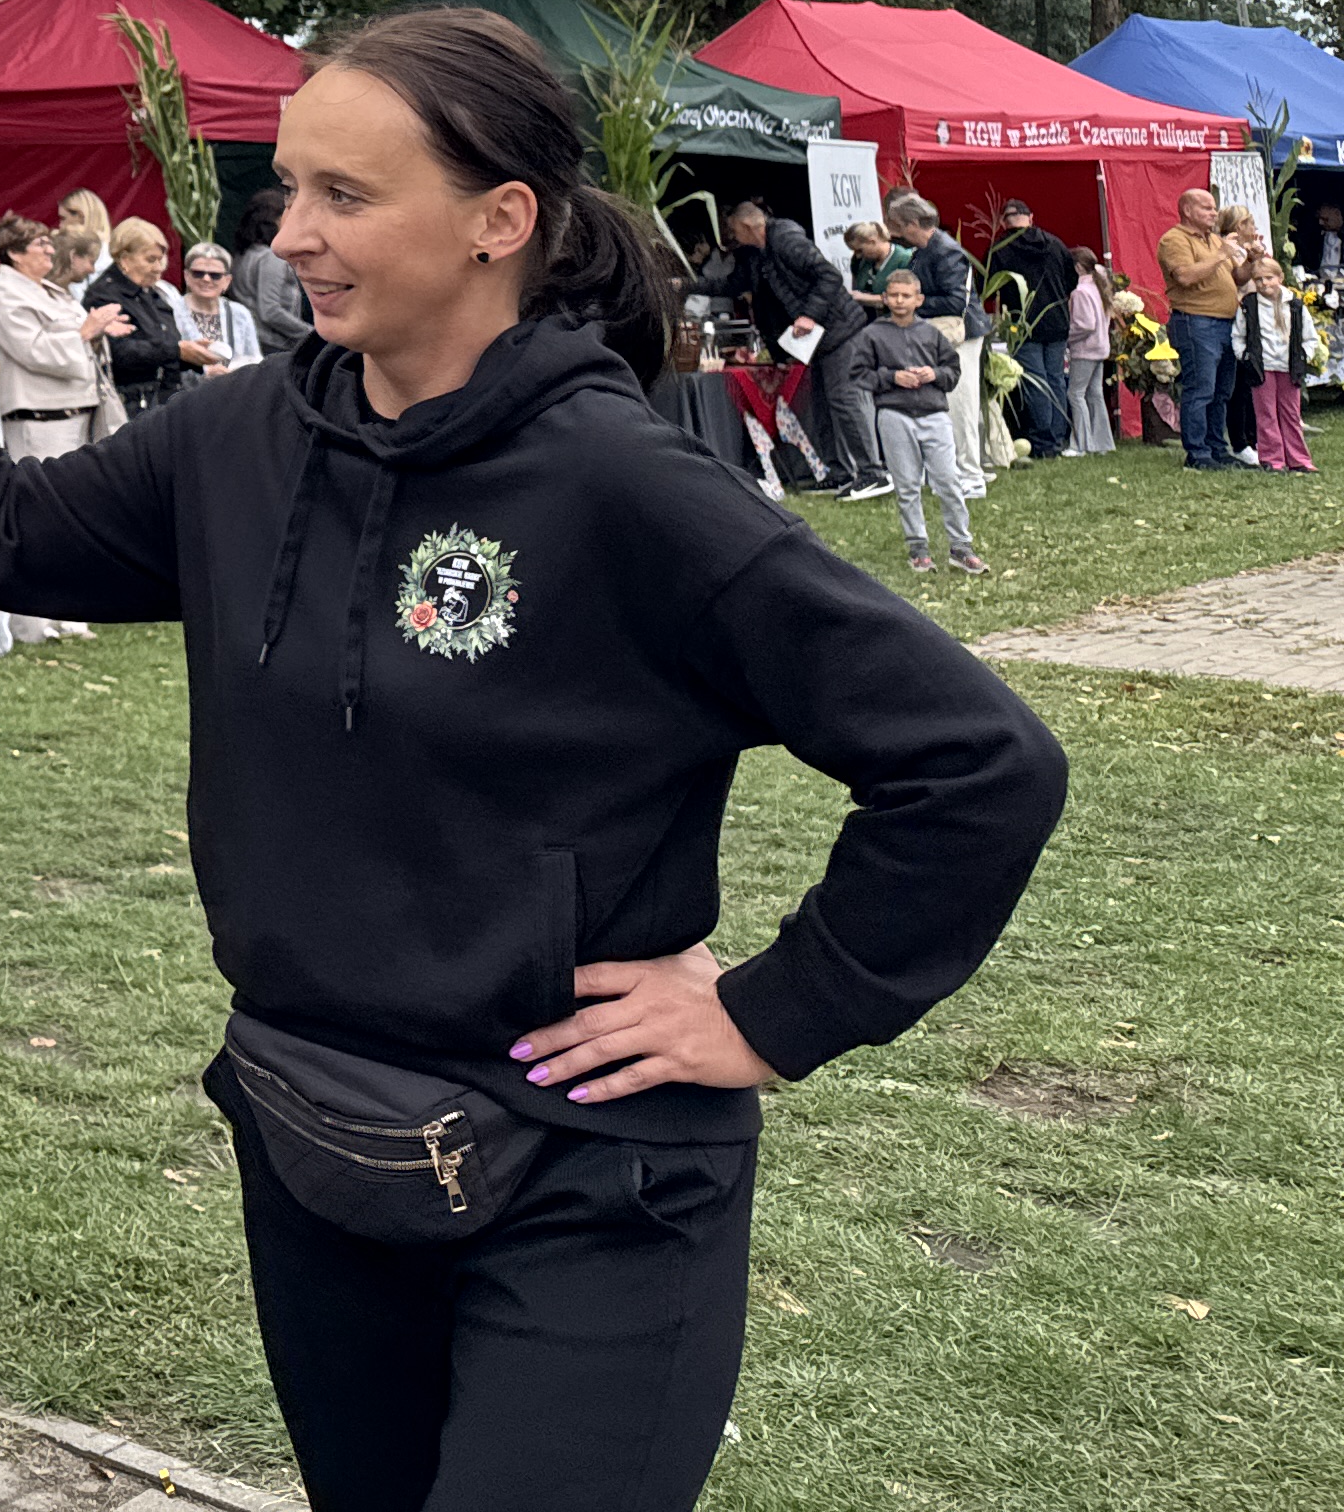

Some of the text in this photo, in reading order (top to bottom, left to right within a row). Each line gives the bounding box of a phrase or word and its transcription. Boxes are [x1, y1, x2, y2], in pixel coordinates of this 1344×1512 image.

[963, 120, 1209, 152] KGW w Modle "Czerwone Tulipany"
[830, 173, 861, 208] KGW
